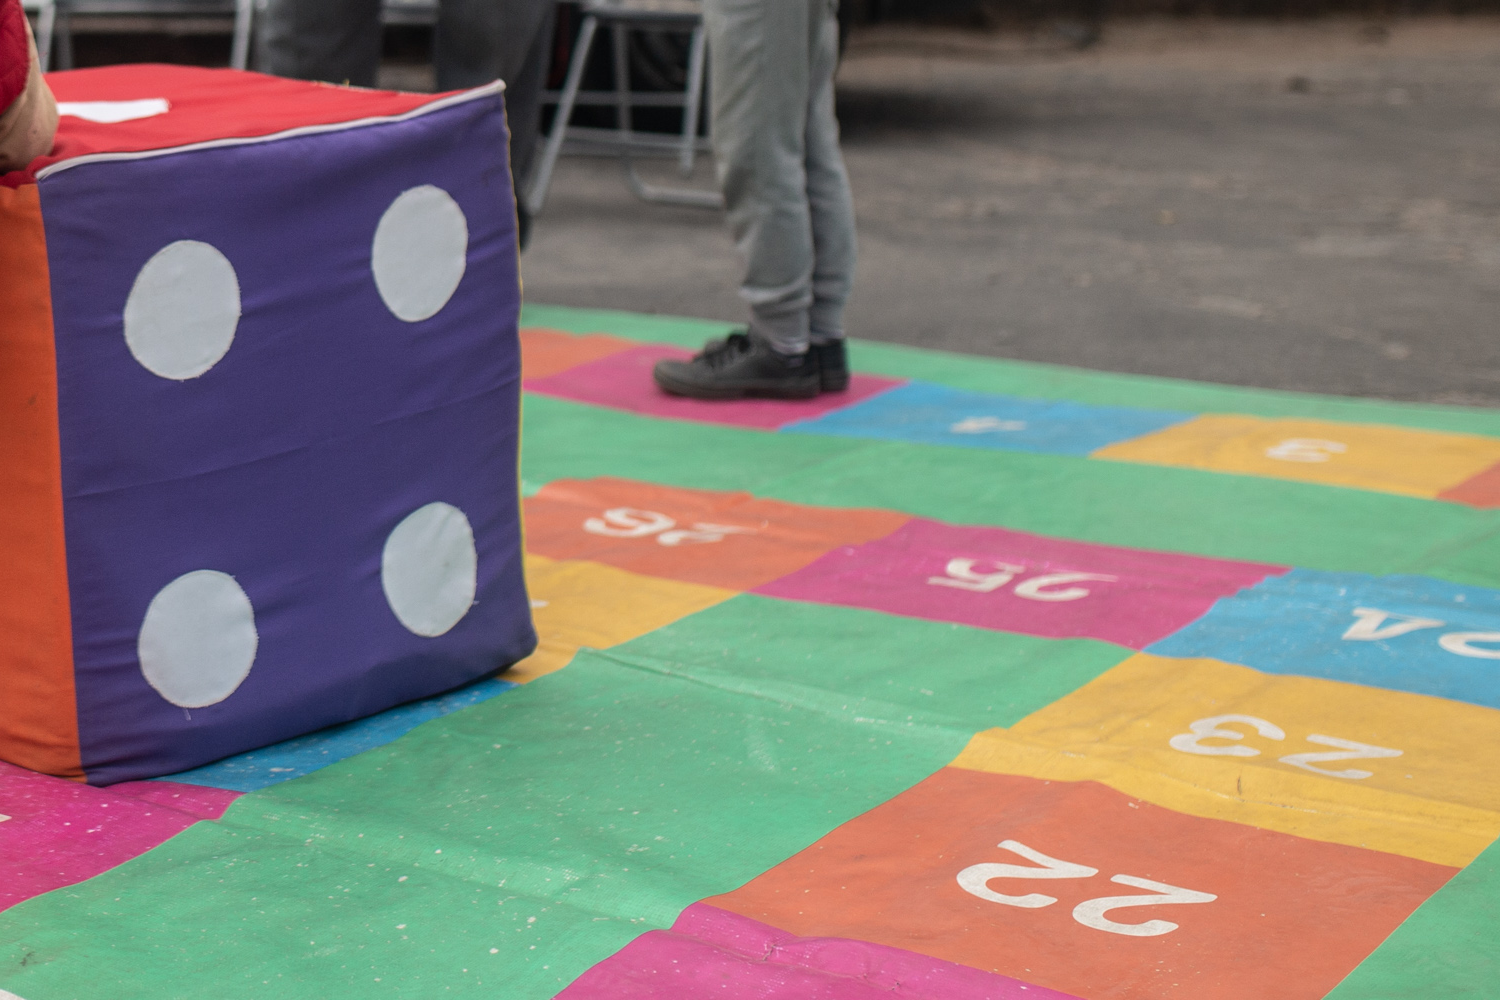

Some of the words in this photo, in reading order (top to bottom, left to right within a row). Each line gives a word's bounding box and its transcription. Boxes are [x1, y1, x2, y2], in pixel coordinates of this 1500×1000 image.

[583, 506, 758, 546] 26
[926, 557, 1120, 602] 25
[1168, 713, 1405, 780] 23
[955, 838, 1219, 938] 22
